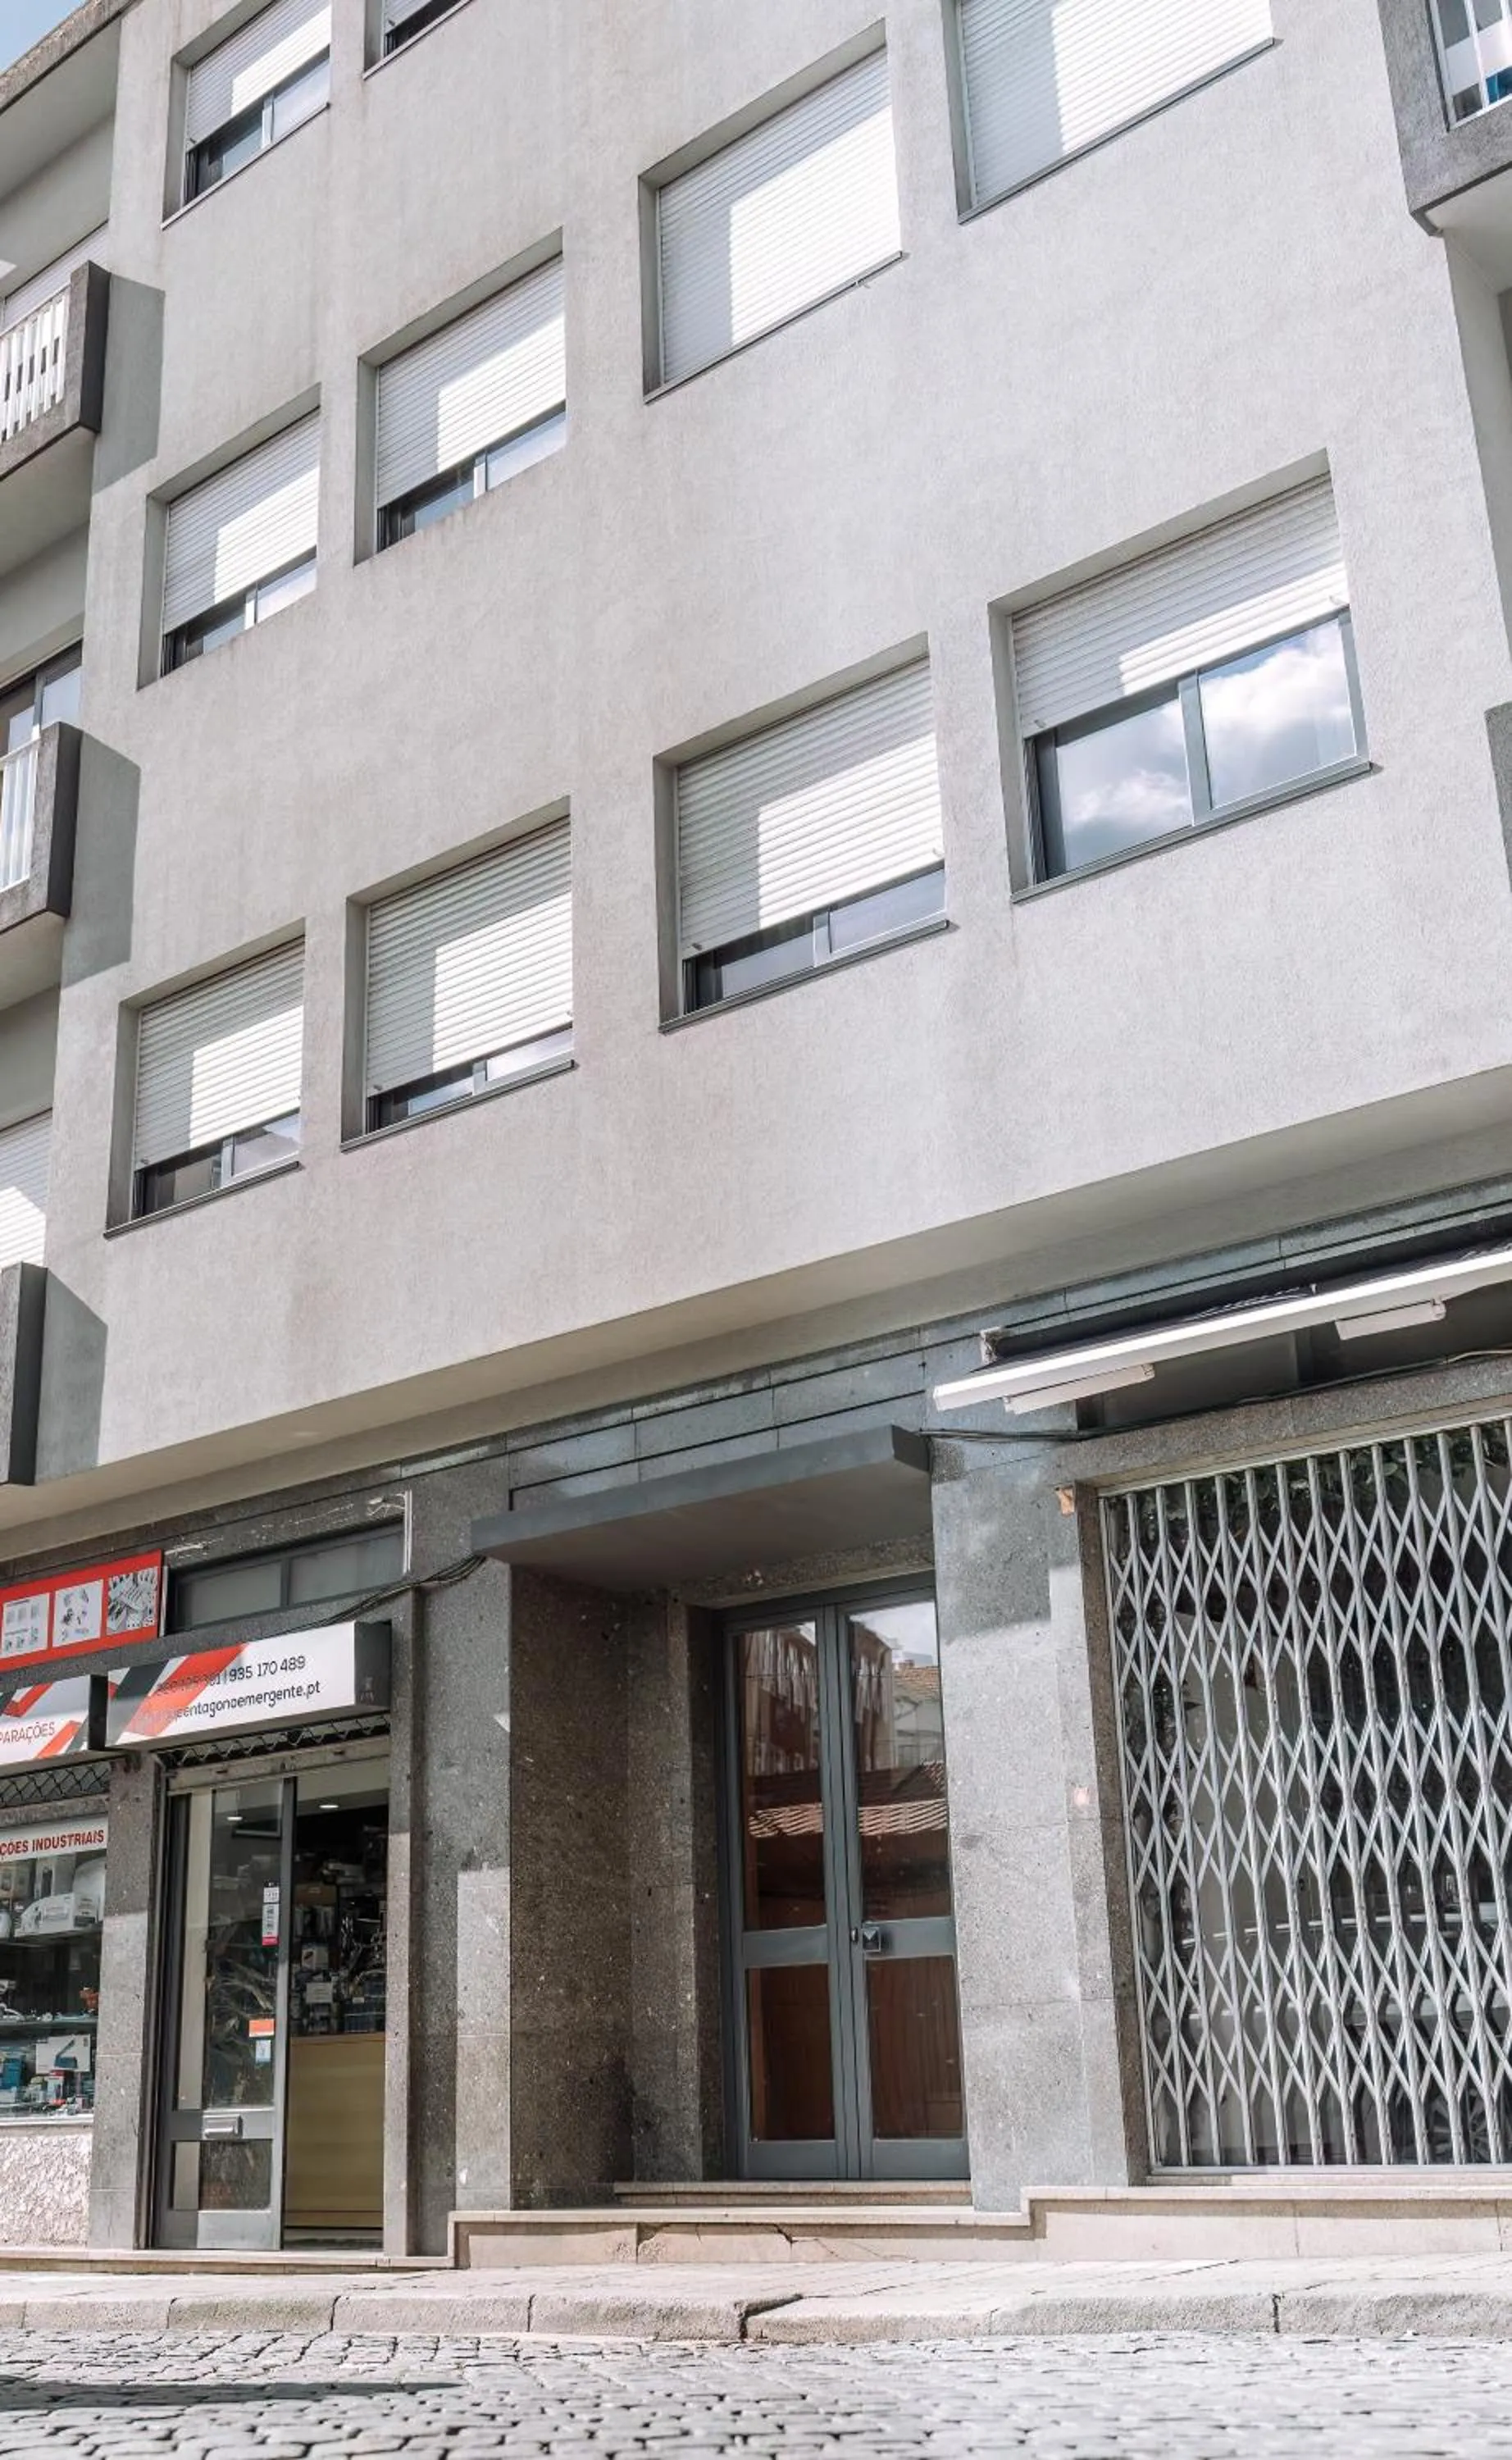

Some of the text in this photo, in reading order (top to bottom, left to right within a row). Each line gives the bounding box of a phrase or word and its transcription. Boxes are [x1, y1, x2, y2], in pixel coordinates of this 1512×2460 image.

[230, 1665, 253, 1682] 935
[257, 1660, 278, 1677] 170
[280, 1656, 307, 1672] 489
[32, 1829, 104, 1852] INDUSTRIAIS
